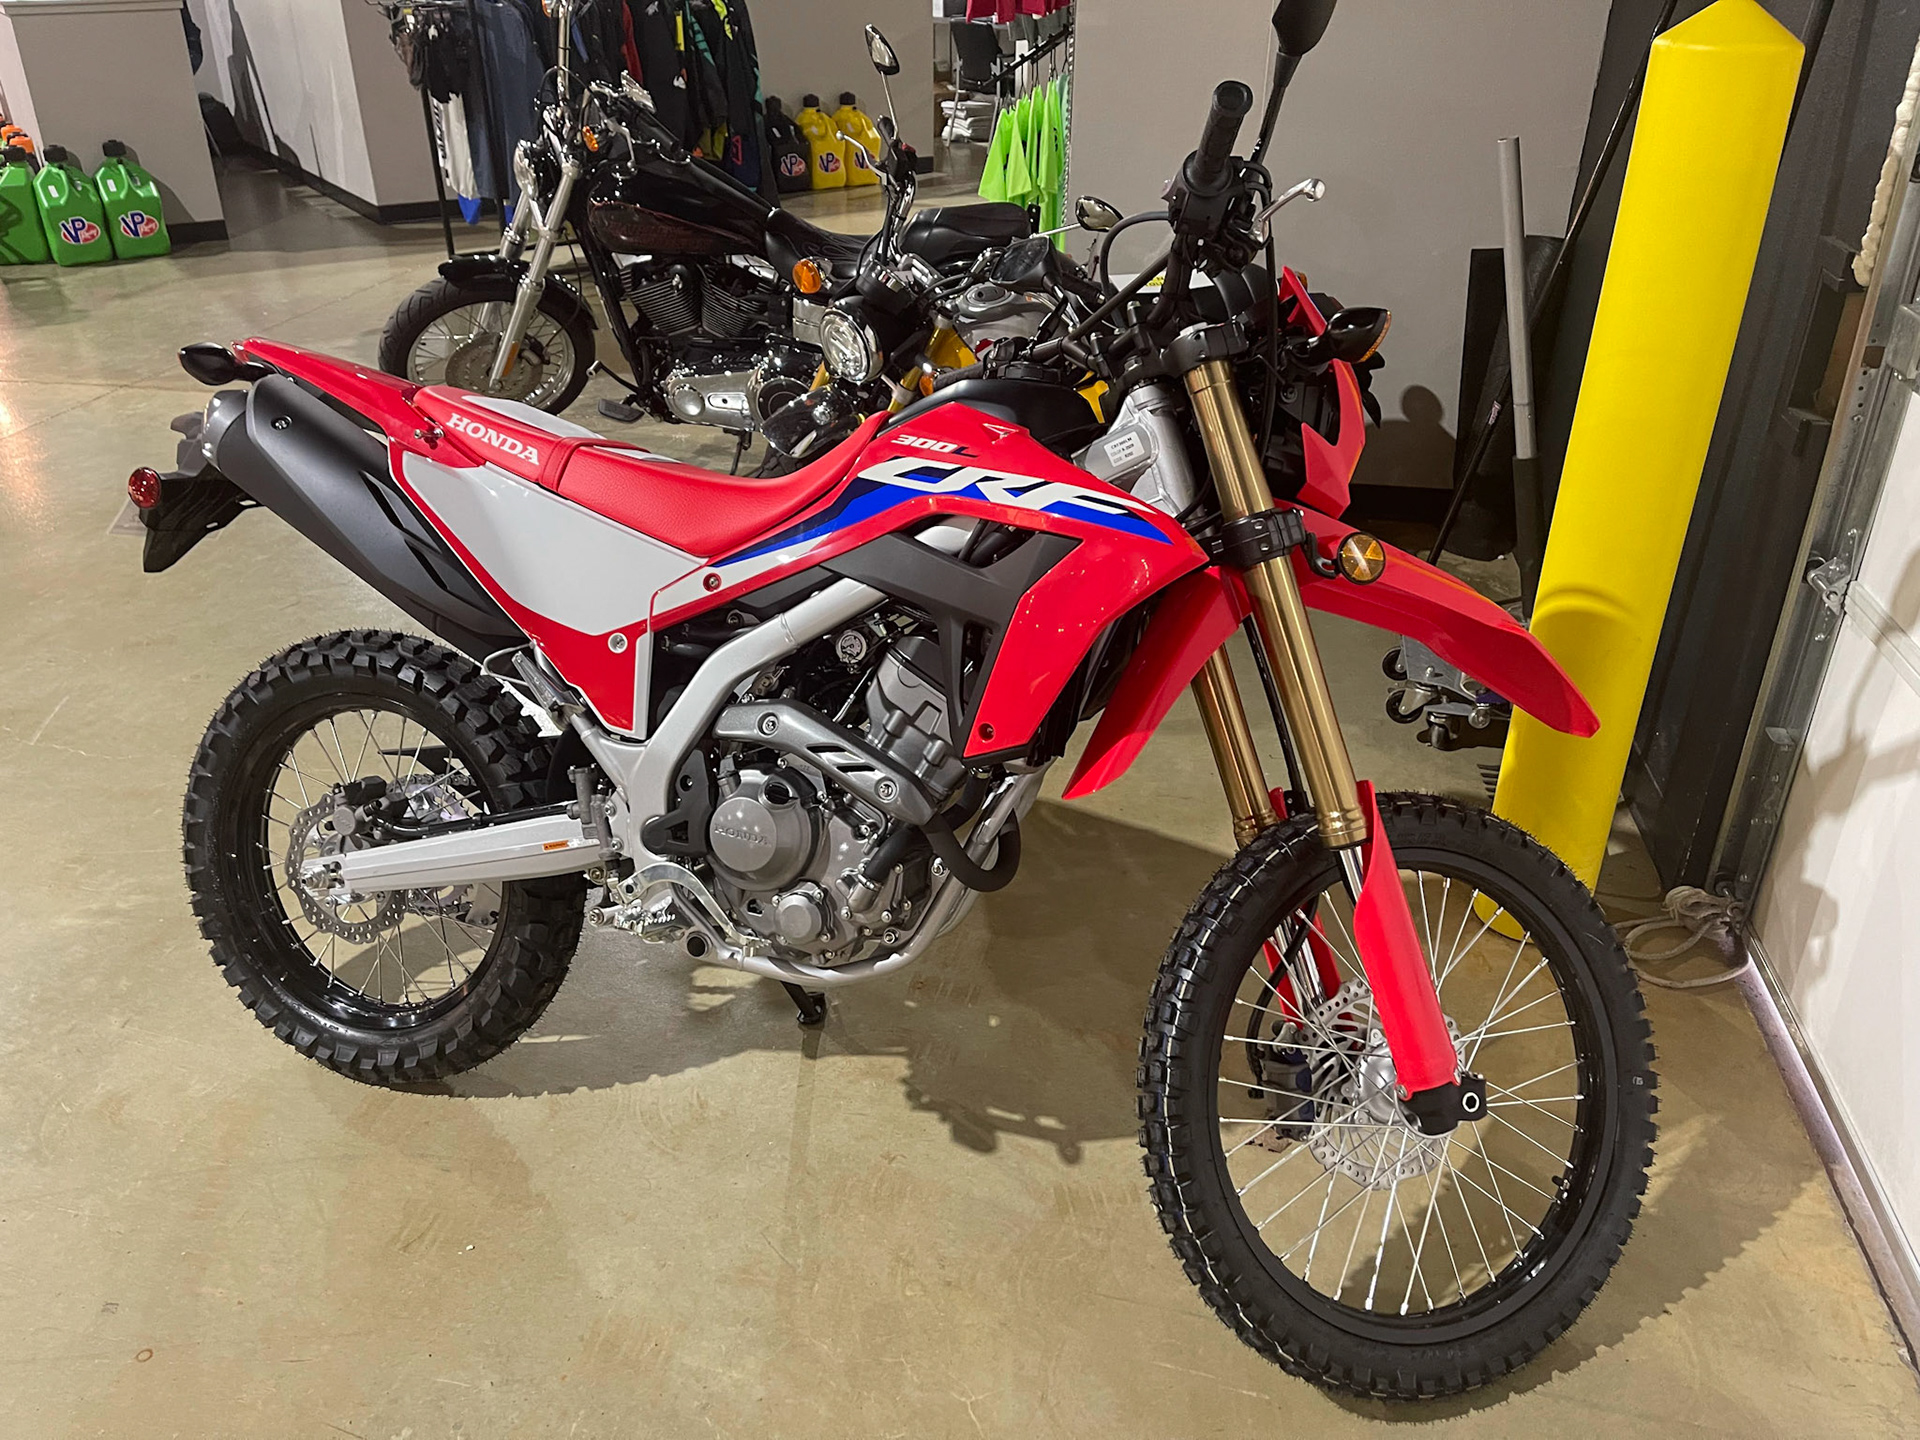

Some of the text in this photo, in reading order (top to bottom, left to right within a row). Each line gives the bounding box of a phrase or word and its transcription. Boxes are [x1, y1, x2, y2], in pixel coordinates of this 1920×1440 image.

[781, 153, 799, 175] VP
[819, 152, 835, 173] VP
[60, 216, 87, 244] VP
[119, 210, 146, 238] VP
[445, 412, 540, 465] HONDA
[890, 434, 979, 458] 300L
[857, 456, 1158, 515] CRF
[714, 823, 772, 848] HONDA
